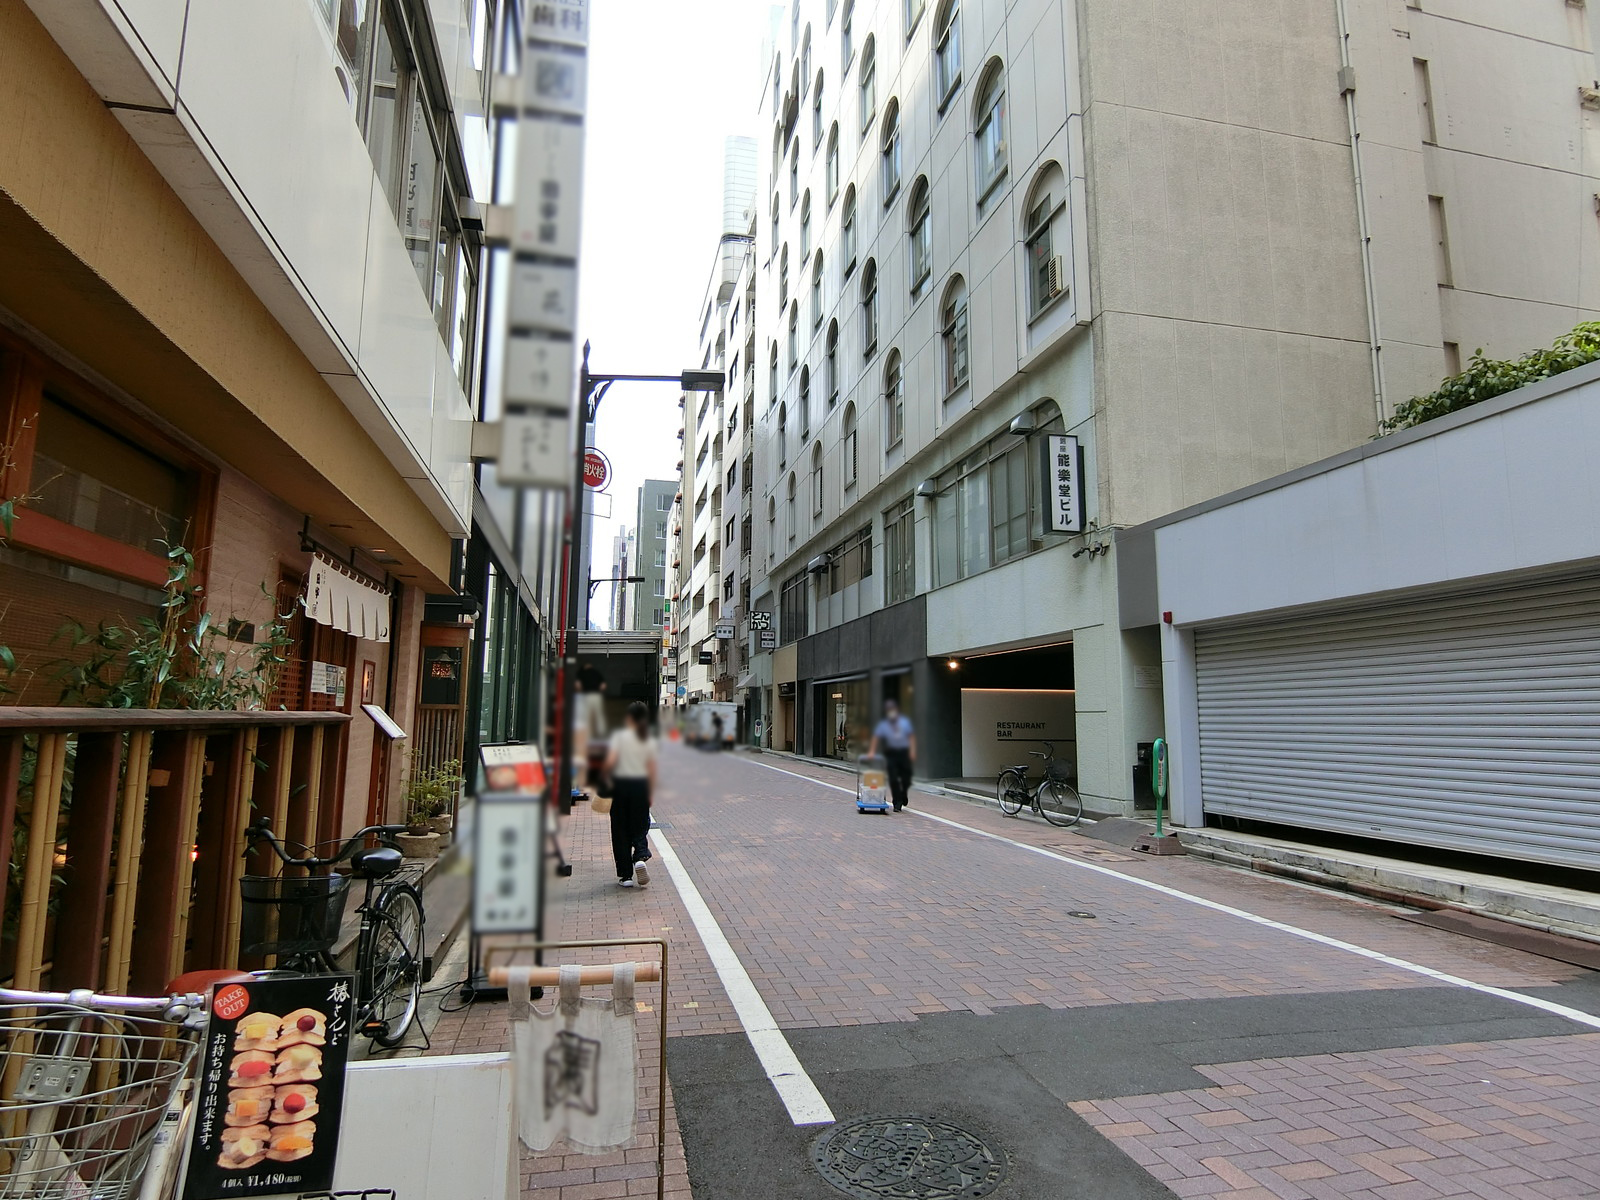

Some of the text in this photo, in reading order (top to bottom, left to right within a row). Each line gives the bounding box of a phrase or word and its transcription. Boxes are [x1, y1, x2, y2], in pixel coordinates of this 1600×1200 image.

[997, 721, 1046, 729] RESTAURANT
[997, 730, 1013, 738] BAR
[215, 987, 245, 1009] TAKE
[222, 998, 245, 1017] OUT
[199, 1032, 227, 1151] お持ち帰り出来ます。
